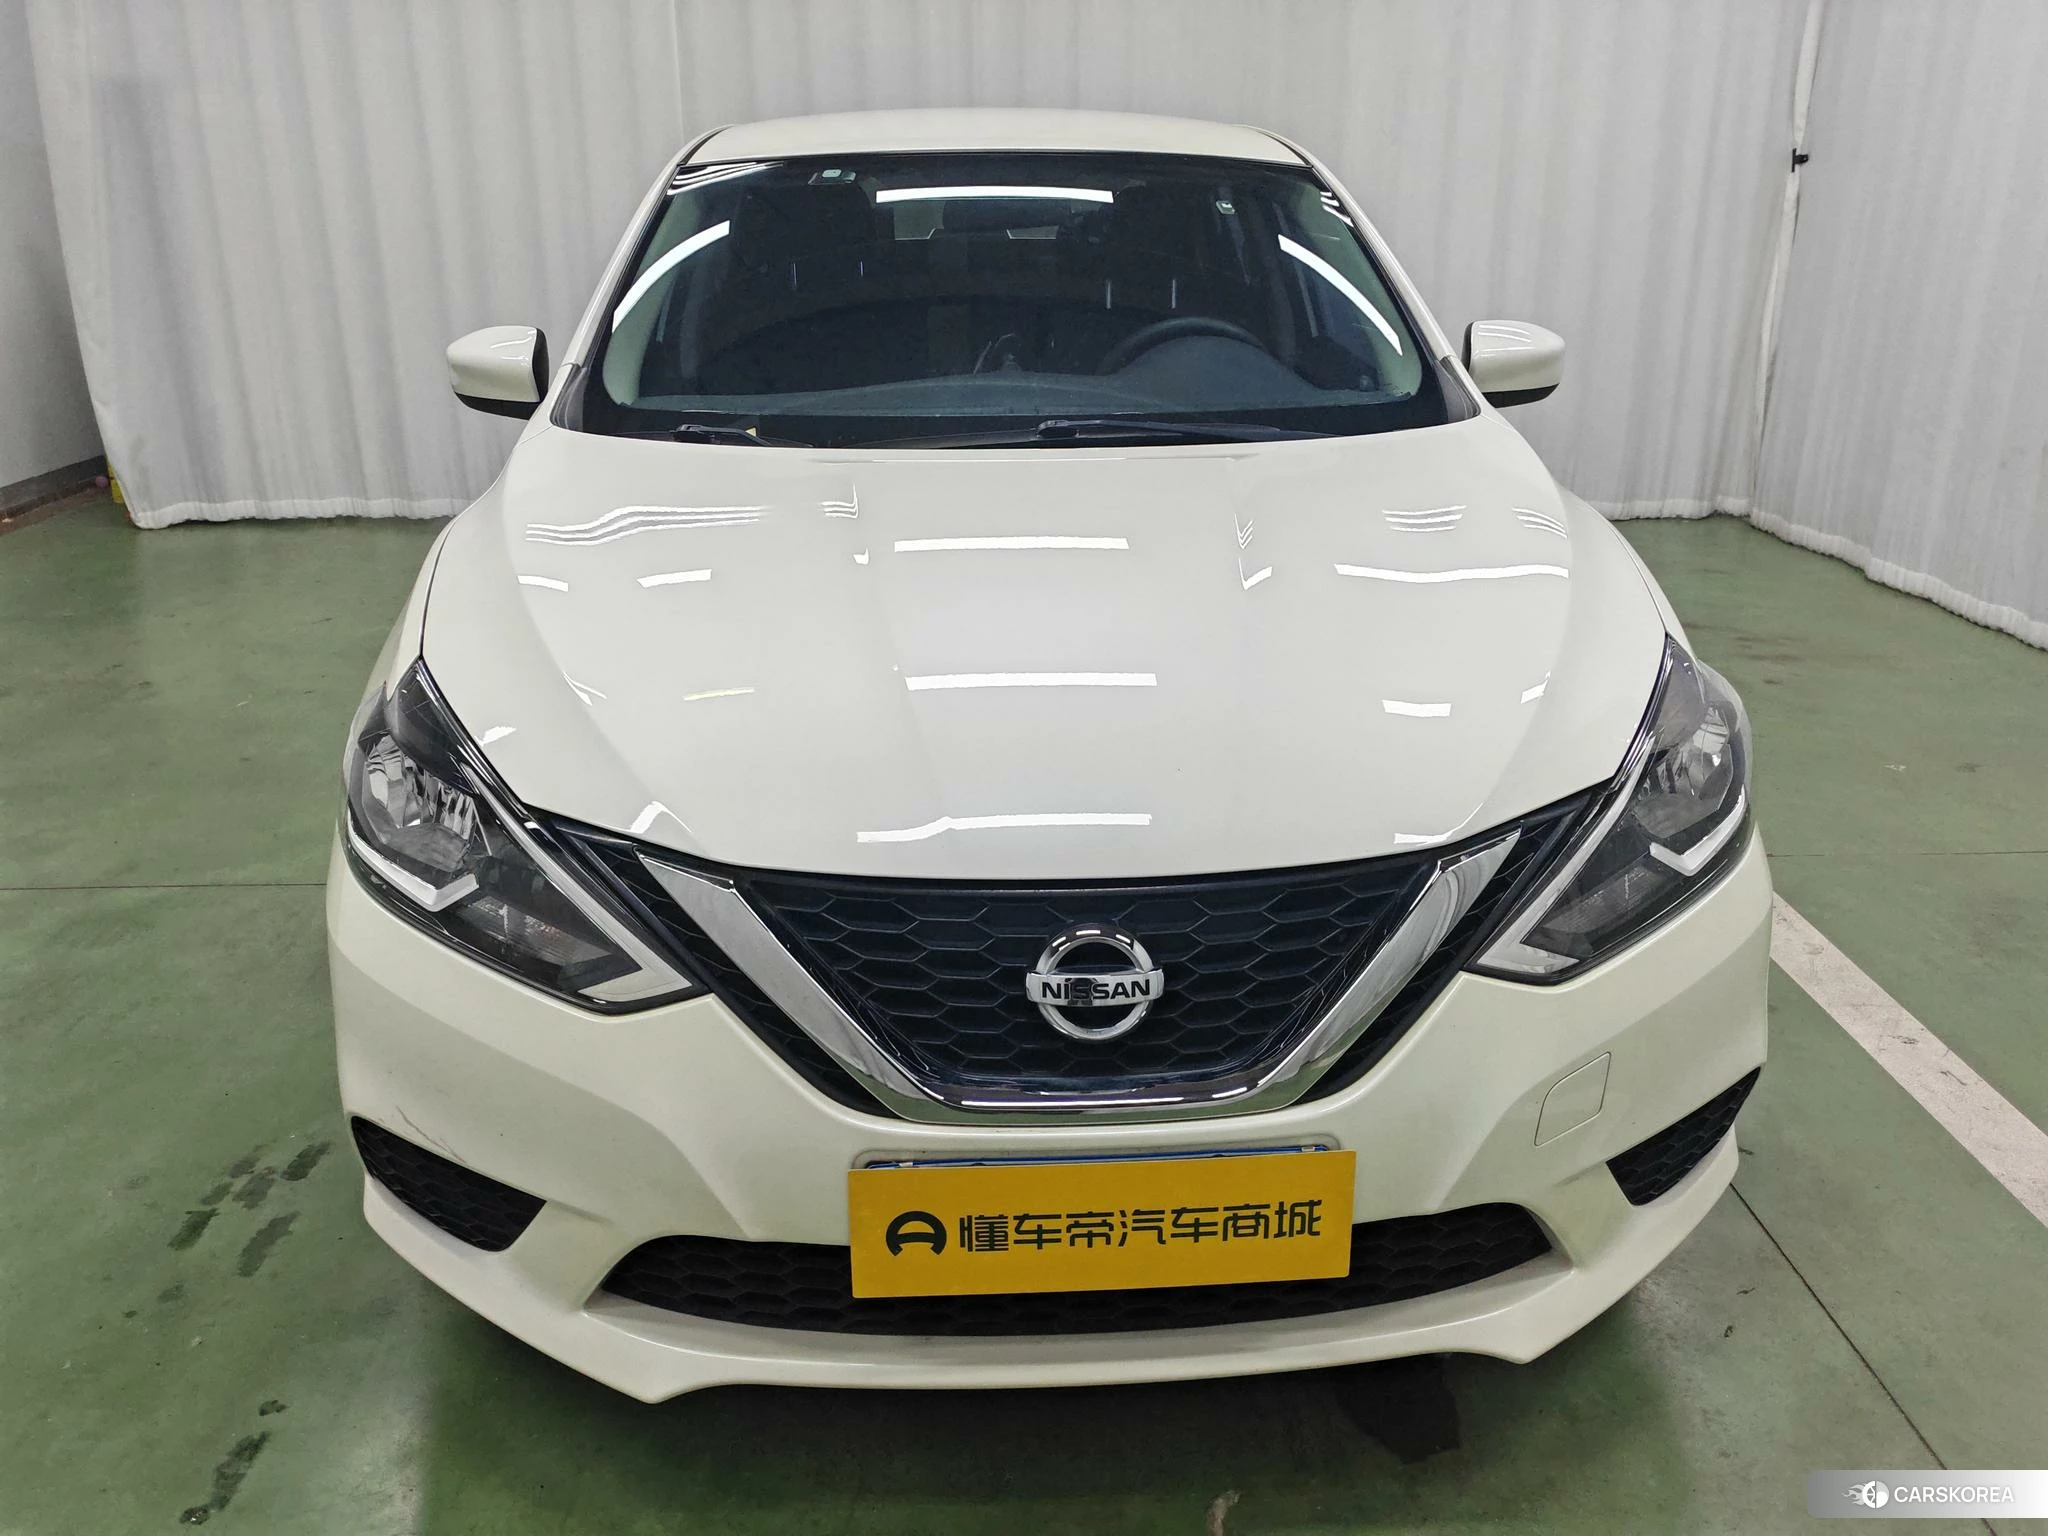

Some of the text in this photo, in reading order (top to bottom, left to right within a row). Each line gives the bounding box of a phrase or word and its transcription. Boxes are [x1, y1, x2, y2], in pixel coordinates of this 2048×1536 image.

[1042, 978, 1150, 1000] NISSAN
[959, 1199, 1323, 1253] 懂车帝汽车商城
